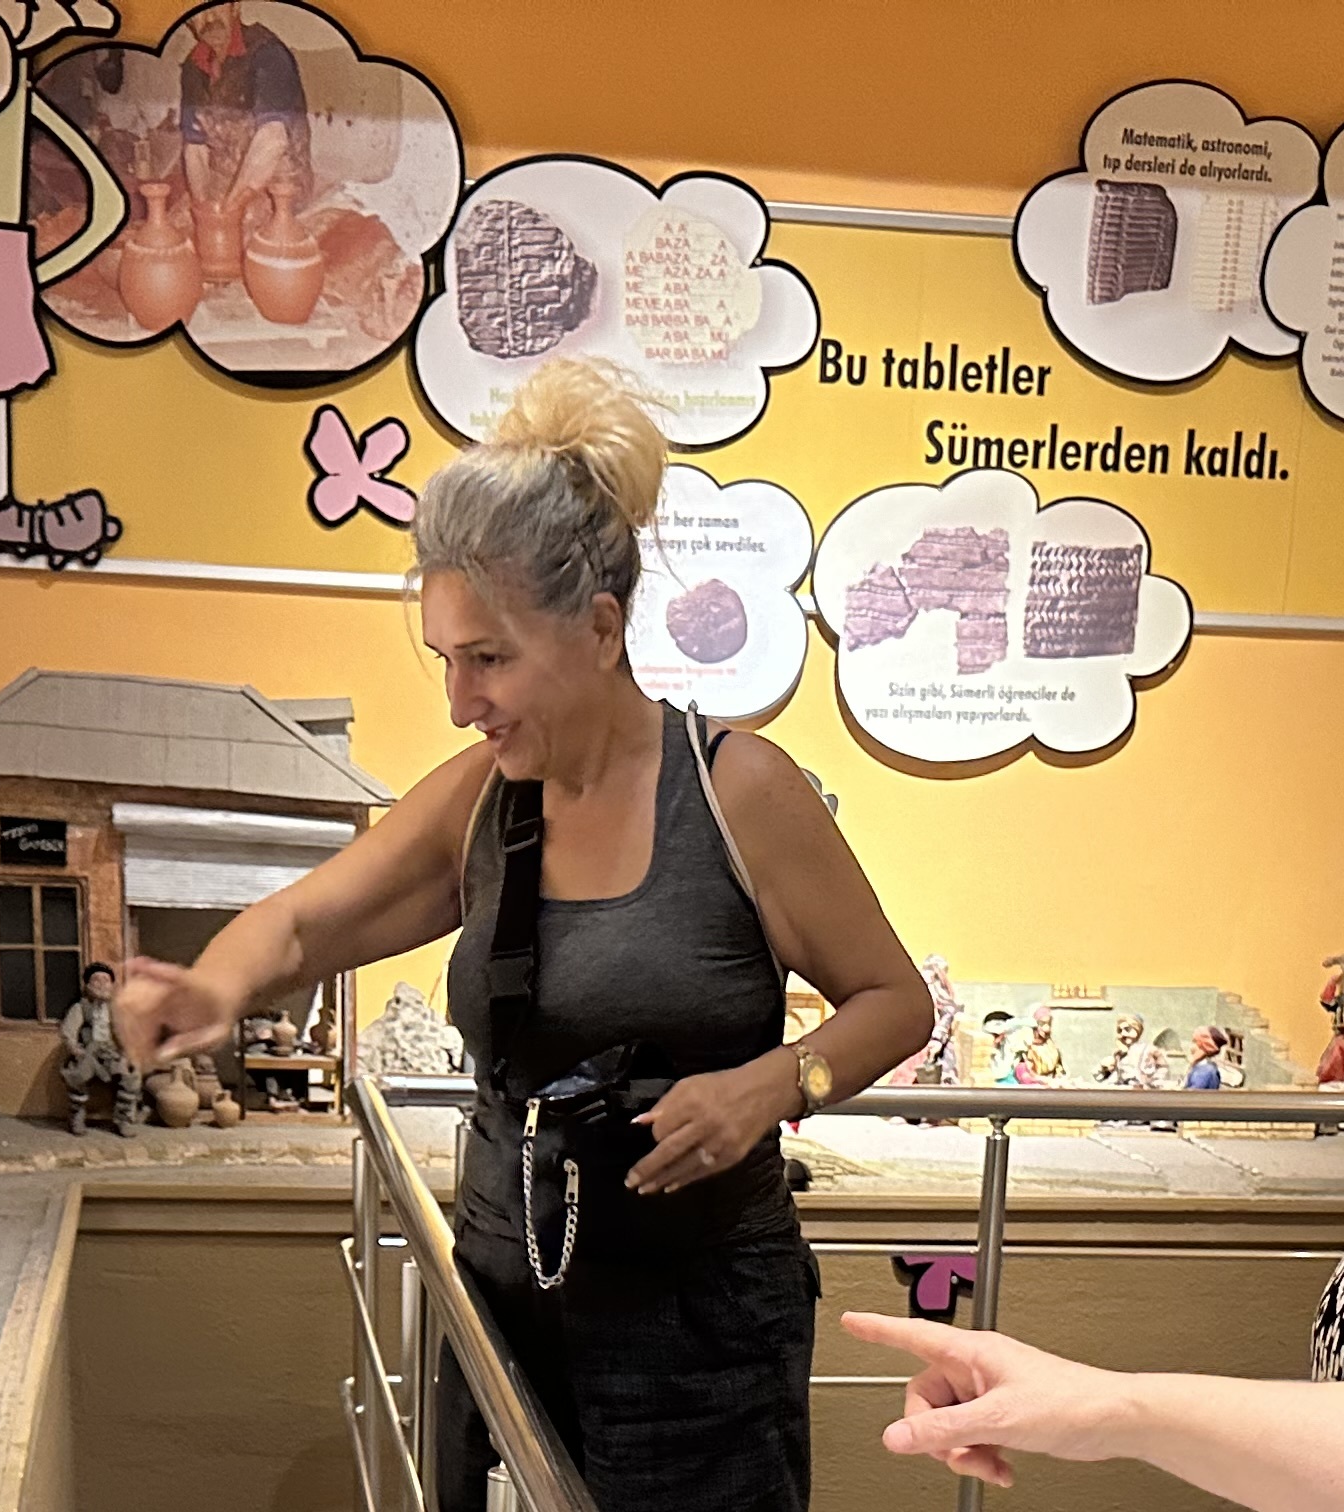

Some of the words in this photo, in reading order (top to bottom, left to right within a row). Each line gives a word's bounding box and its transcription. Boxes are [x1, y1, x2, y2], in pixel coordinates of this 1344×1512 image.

[1122, 128, 1198, 153] Matematik,
[1201, 138, 1272, 160] astronomi,
[1103, 154, 1120, 173] tıp
[1125, 154, 1176, 174] dersleri
[1179, 158, 1195, 176] de
[1200, 160, 1272, 182] alıyorlardı.
[819, 339, 866, 384] Bu
[882, 342, 1052, 397] tabletler
[925, 419, 1169, 474] Sümerlerden
[1184, 429, 1289, 481] kaldı.
